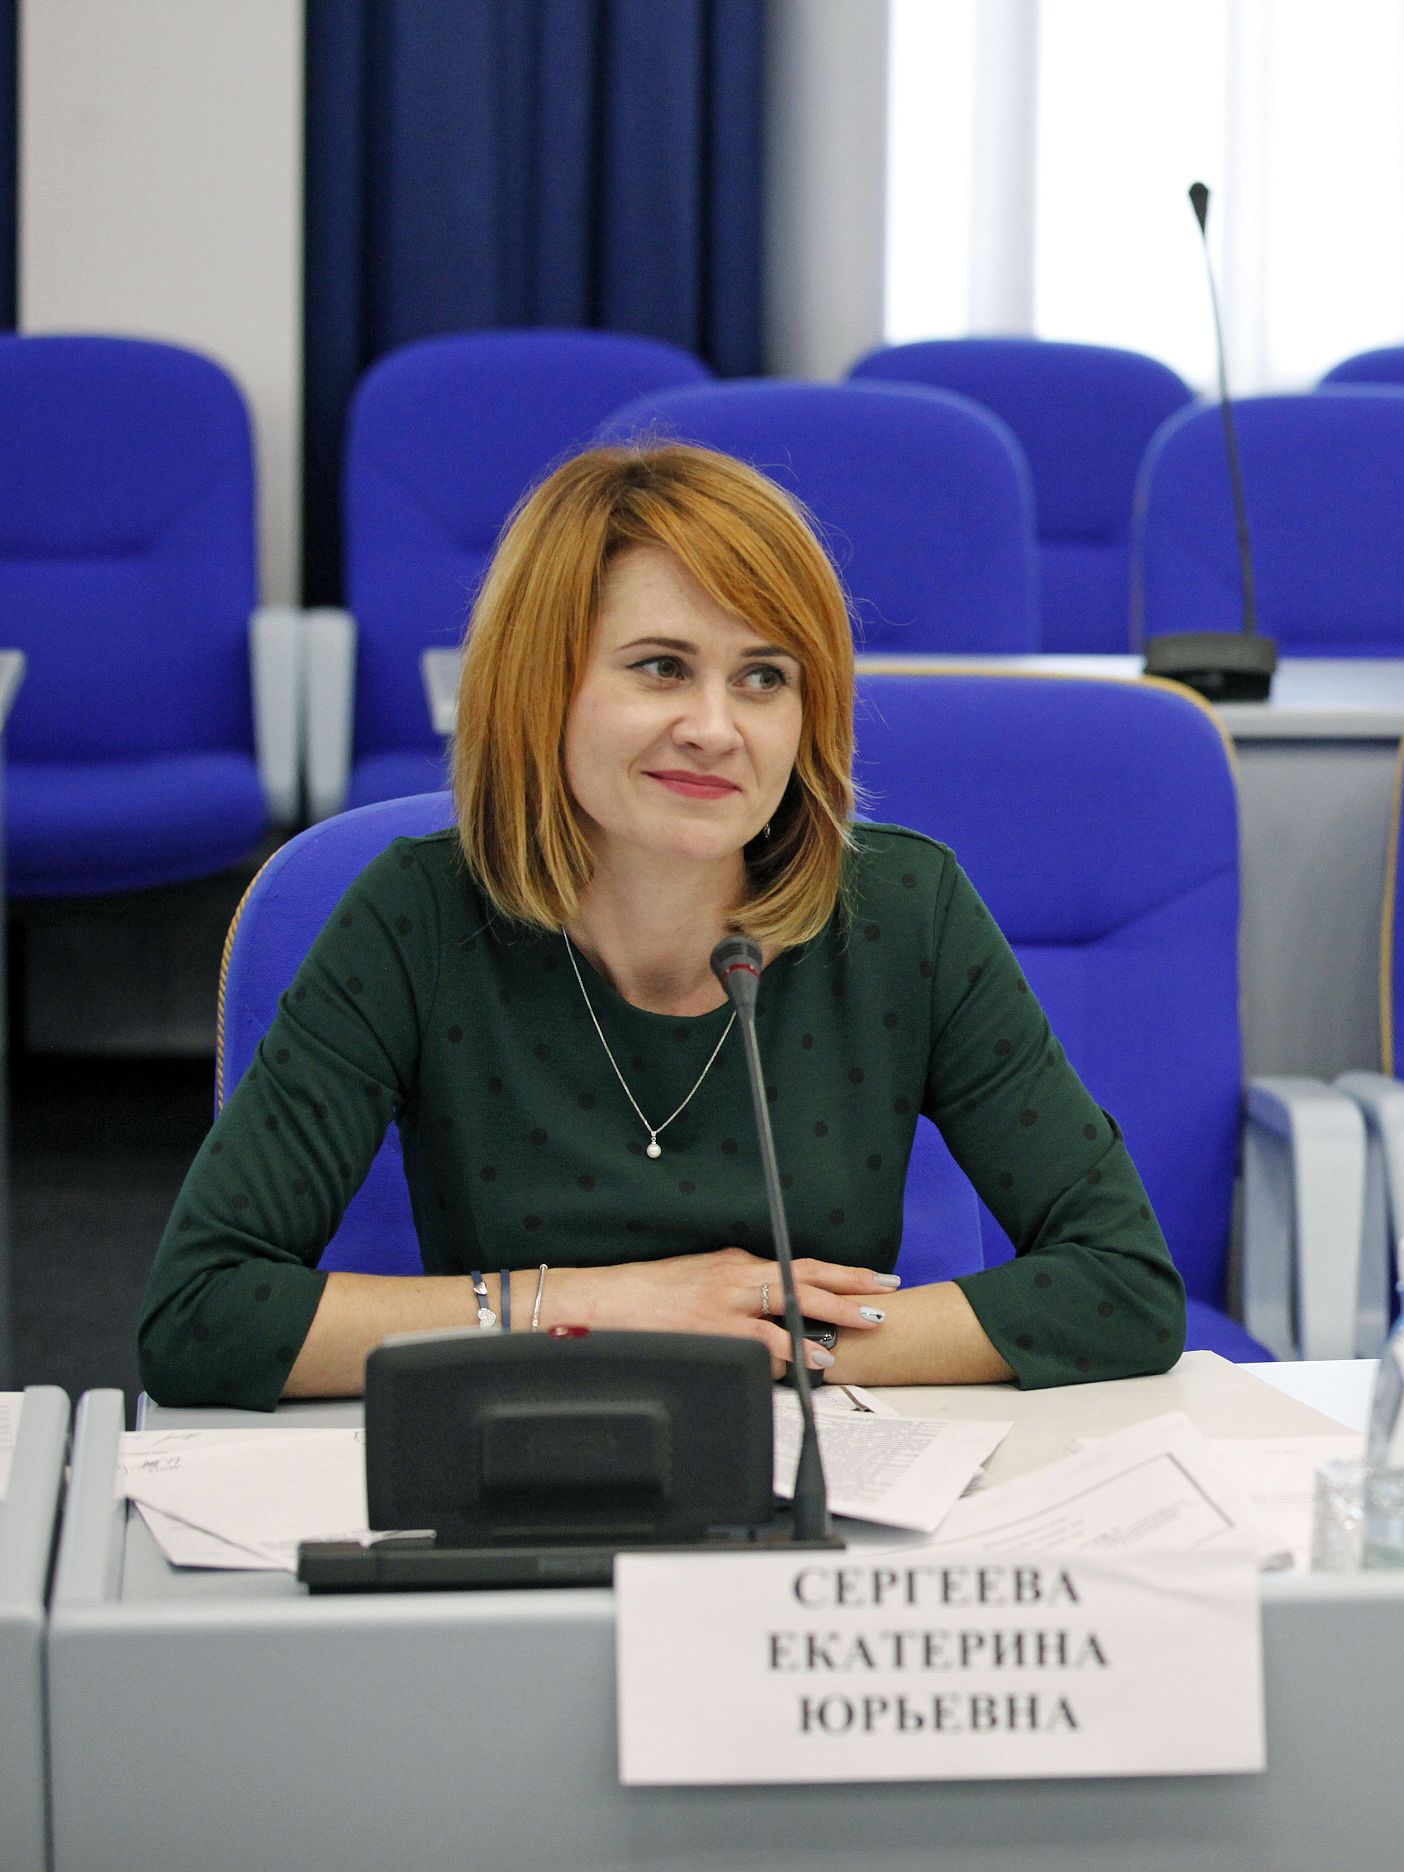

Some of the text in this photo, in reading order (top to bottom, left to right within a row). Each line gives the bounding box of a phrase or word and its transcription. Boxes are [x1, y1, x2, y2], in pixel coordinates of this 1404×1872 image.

[791, 1567, 1081, 1607] СЕРГЕЕВА
[768, 1630, 1109, 1671] ЕКАТЕРИНА
[799, 1693, 1081, 1735] ЮРЬЕВНА
